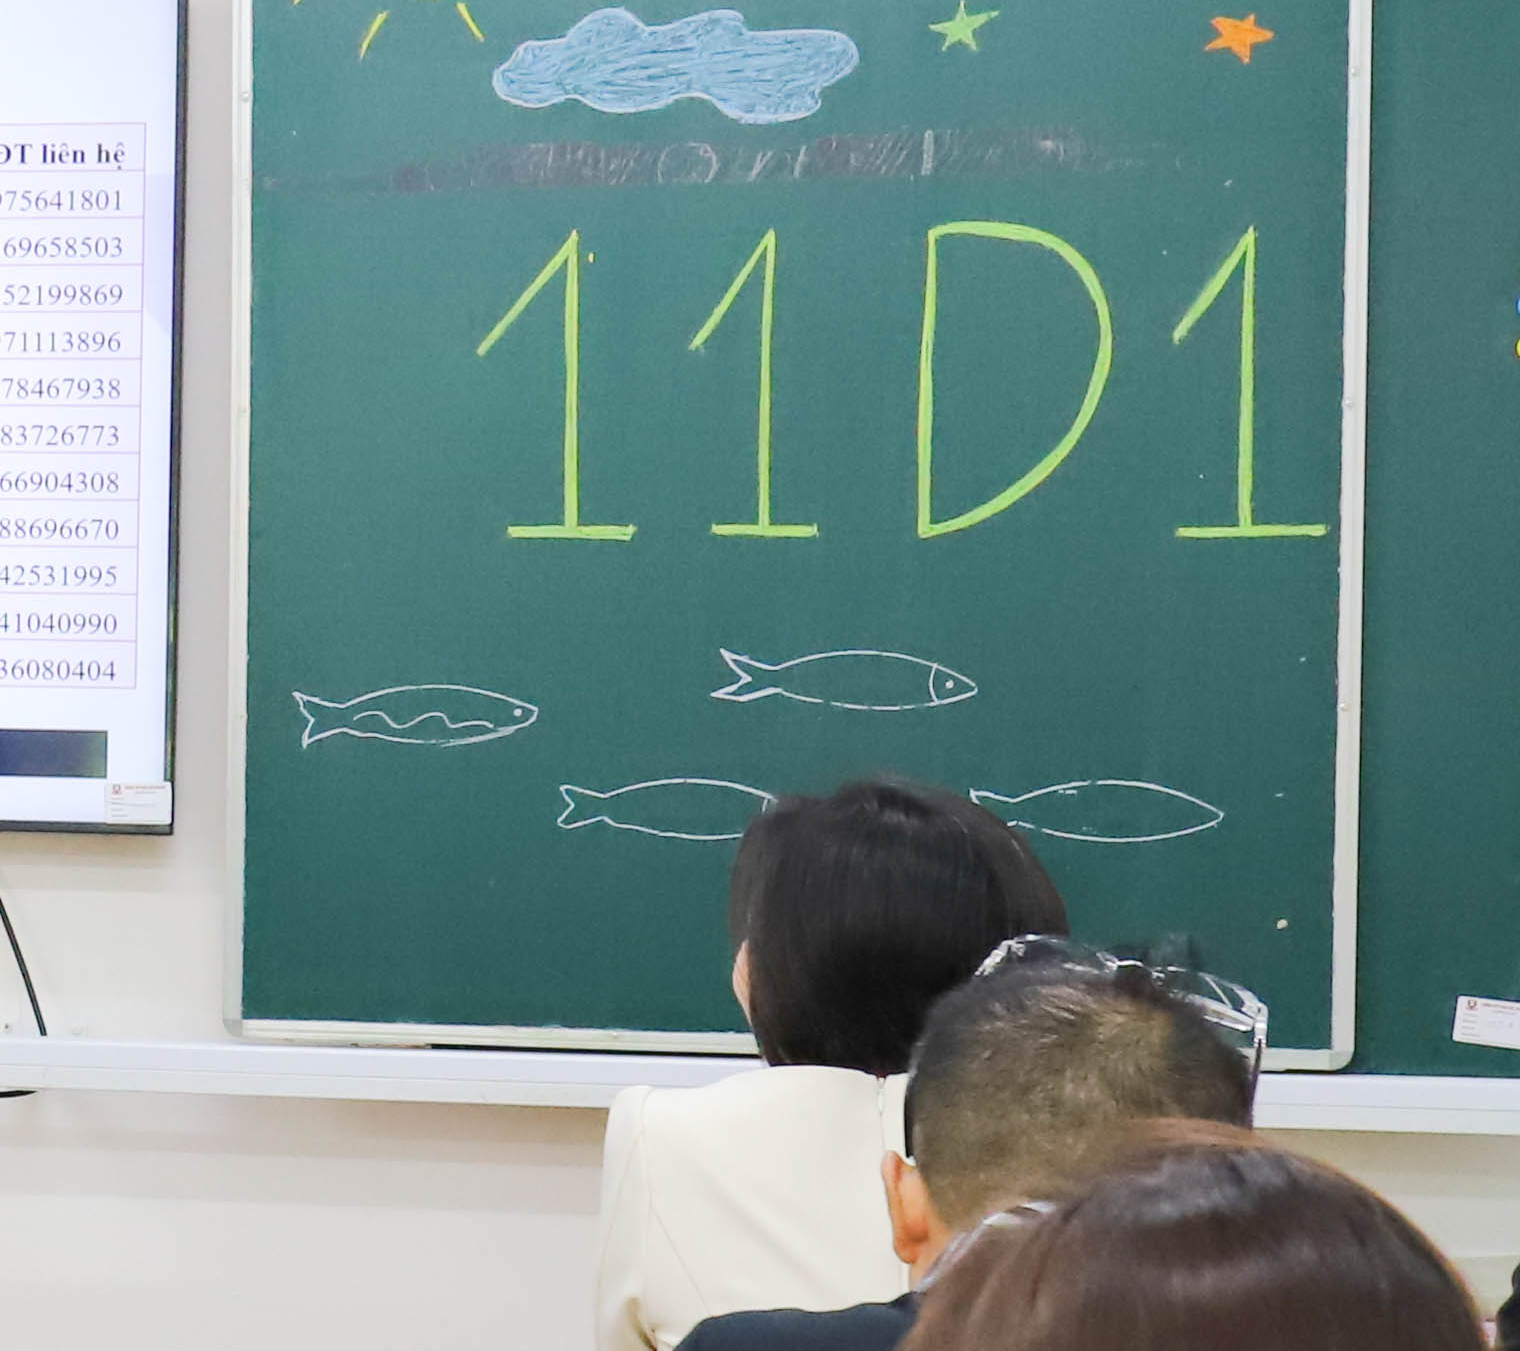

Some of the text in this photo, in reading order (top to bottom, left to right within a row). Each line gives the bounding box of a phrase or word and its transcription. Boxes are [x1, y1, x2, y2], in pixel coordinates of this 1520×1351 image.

[41, 143, 86, 164] liên
[97, 142, 126, 170] hệ
[476, 220, 1331, 541] 11D1
